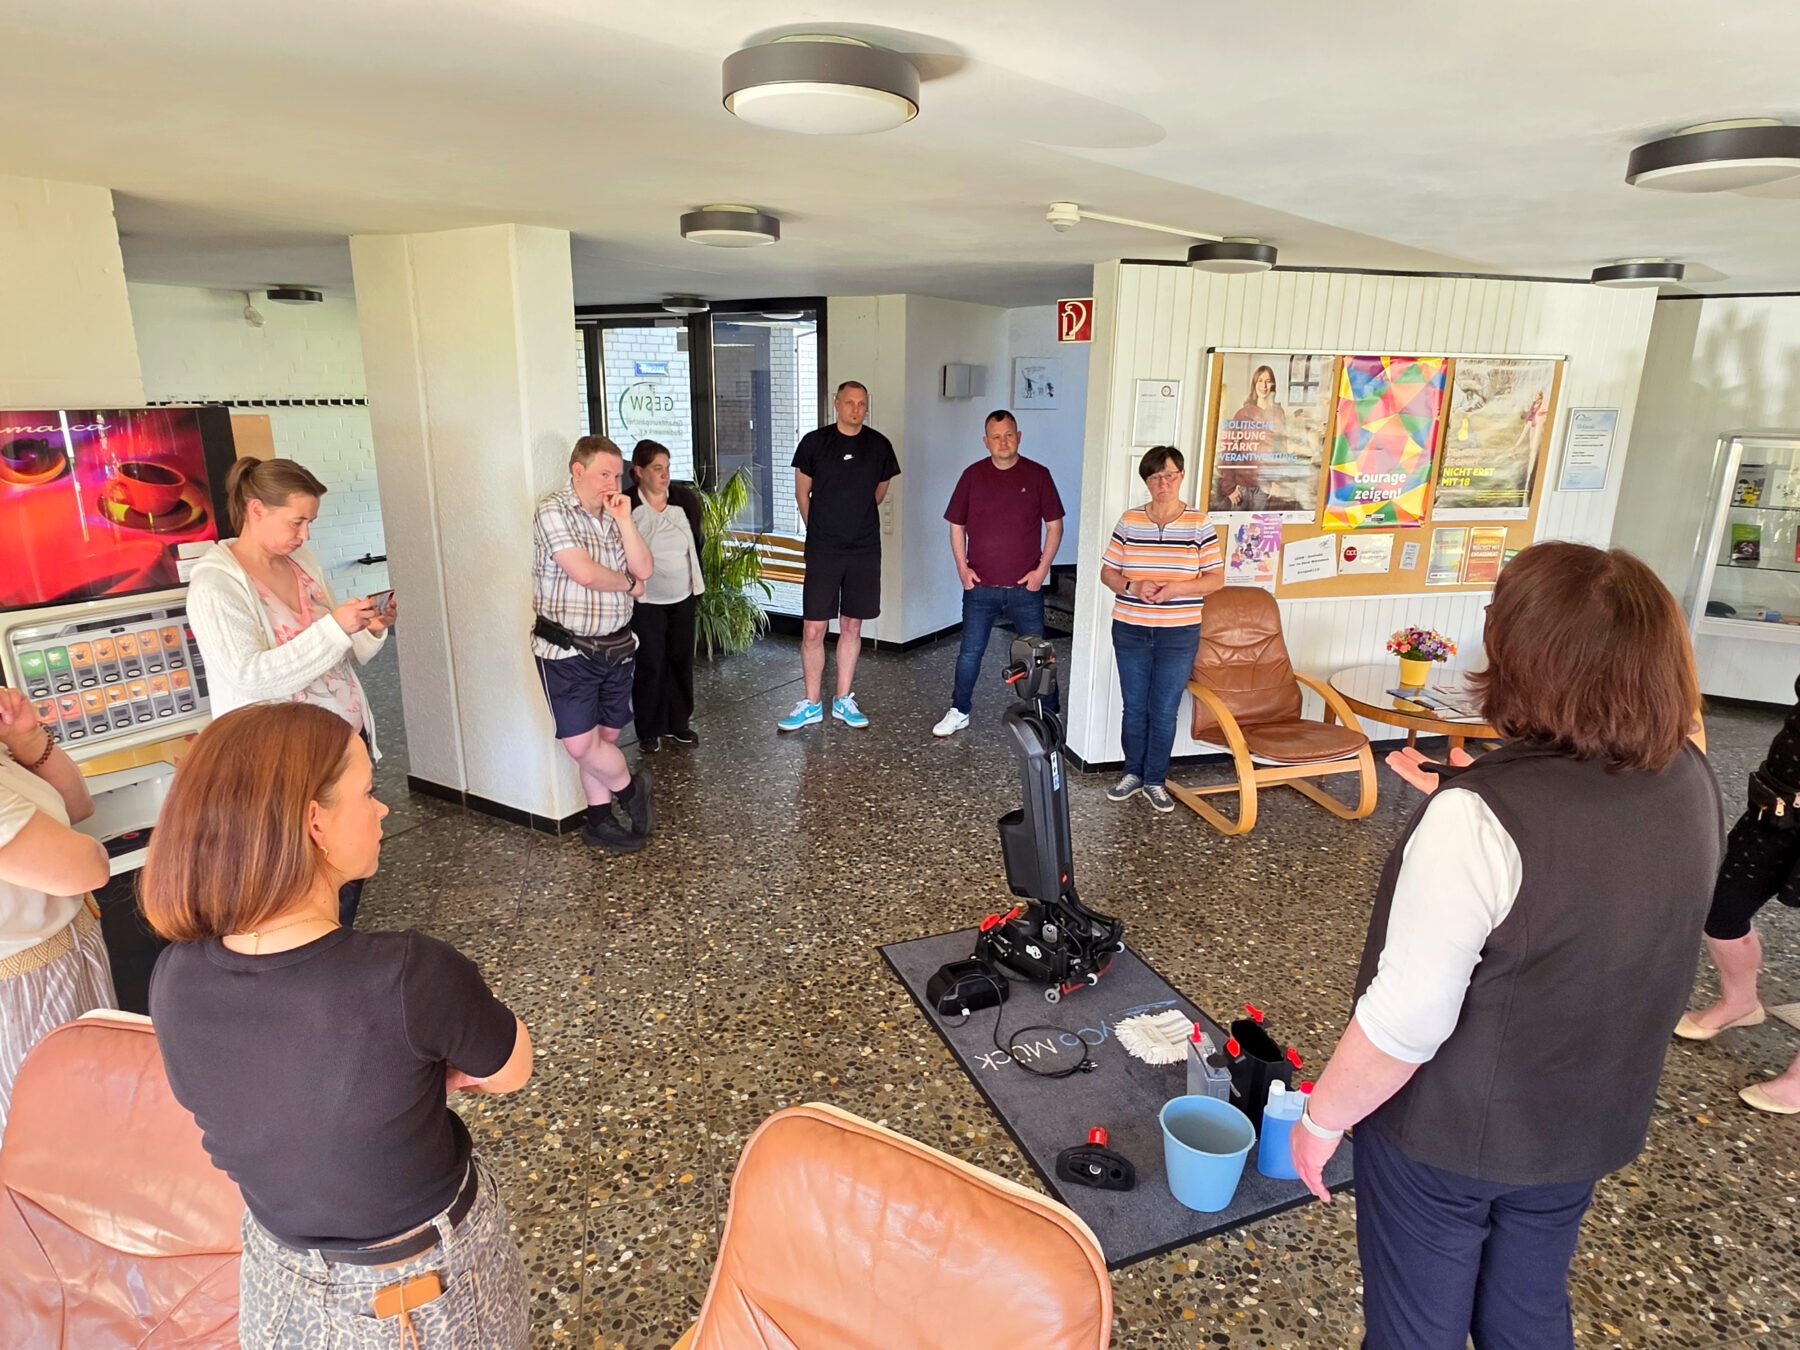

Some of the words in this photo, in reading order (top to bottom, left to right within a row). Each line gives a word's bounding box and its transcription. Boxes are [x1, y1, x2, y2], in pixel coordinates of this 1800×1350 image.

[0, 424, 112, 433] maca
[1222, 431, 1266, 440] BILDUNG
[1220, 441, 1260, 451] STÄRKT
[1443, 467, 1472, 476] NICHT
[1473, 467, 1495, 476] ERST
[1354, 471, 1407, 486] Courage
[1441, 478, 1458, 487] MIT
[1460, 478, 1471, 487] 18
[1354, 486, 1402, 502] zeigen!
